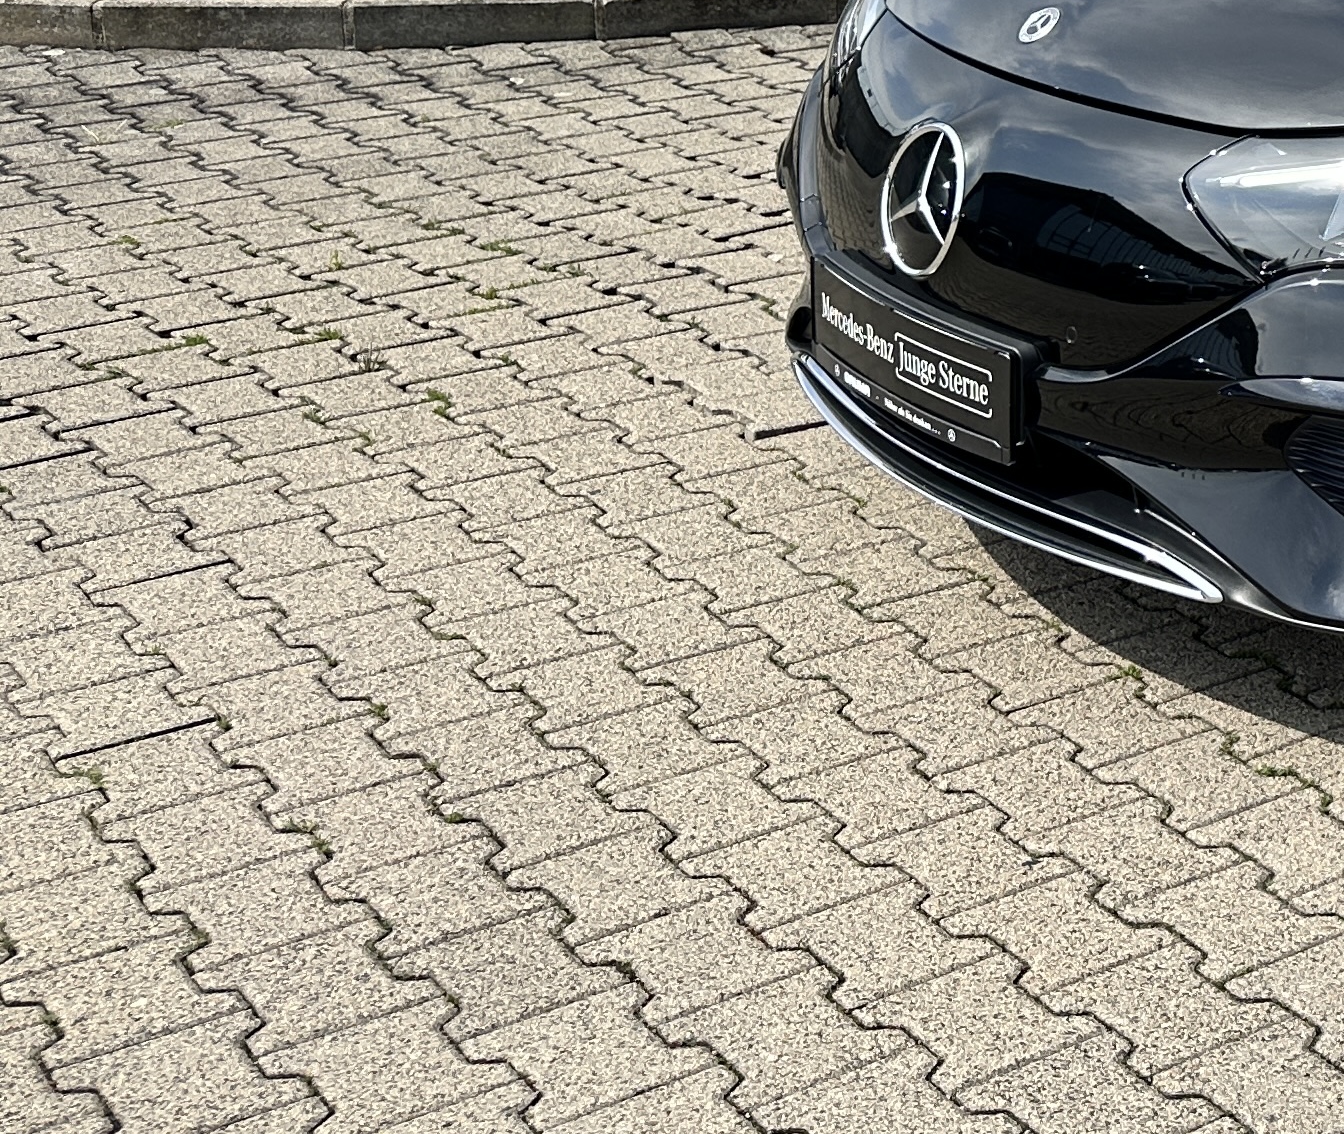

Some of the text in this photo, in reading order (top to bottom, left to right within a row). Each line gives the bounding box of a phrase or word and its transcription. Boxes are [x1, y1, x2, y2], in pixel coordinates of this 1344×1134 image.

[821, 292, 895, 364] Mercedes-Benz
[898, 341, 936, 385] Junge
[939, 360, 989, 405] Sterne
